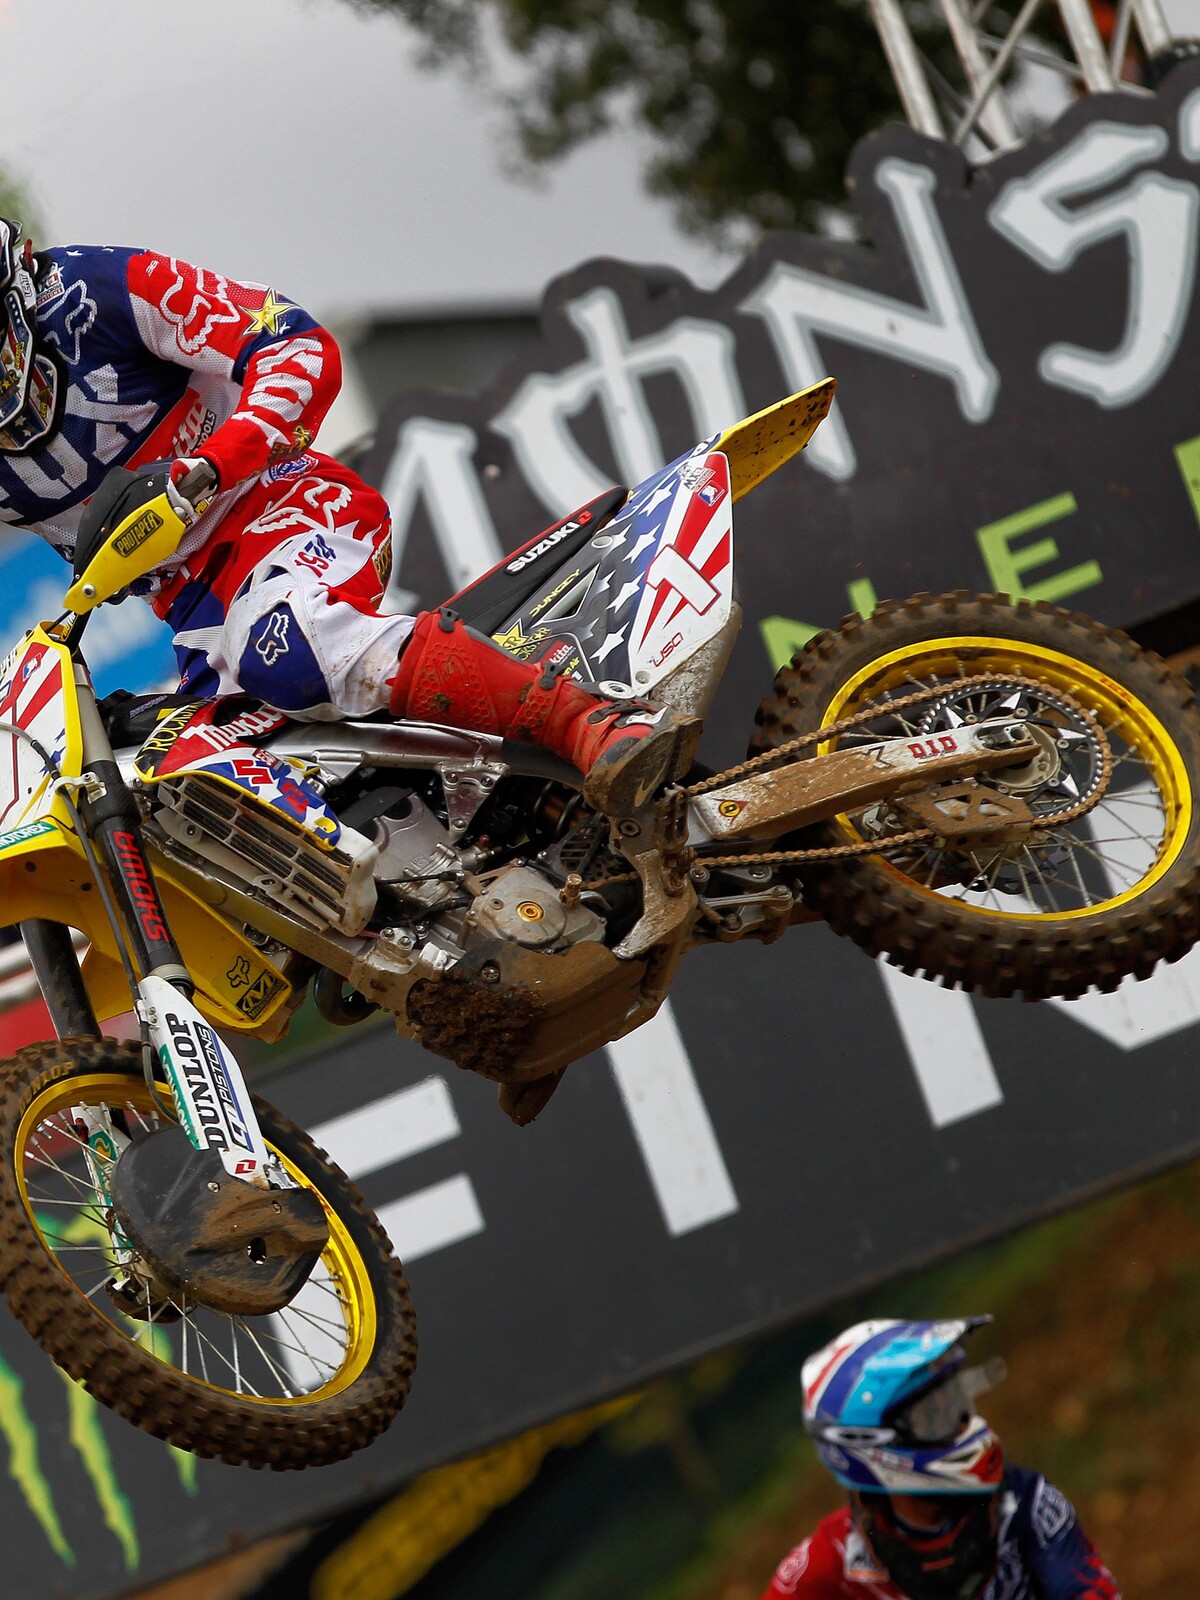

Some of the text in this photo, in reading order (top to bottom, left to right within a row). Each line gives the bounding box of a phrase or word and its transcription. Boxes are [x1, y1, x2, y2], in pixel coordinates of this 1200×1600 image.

[116, 514, 158, 553] PROTAPER
[294, 533, 337, 578] 1974
[506, 522, 581, 573] SUZUKI
[549, 645, 574, 664] kita
[112, 830, 170, 943] SHOWA
[165, 1012, 228, 1152] DUNLOP
[198, 1025, 229, 1103] PISTONS
